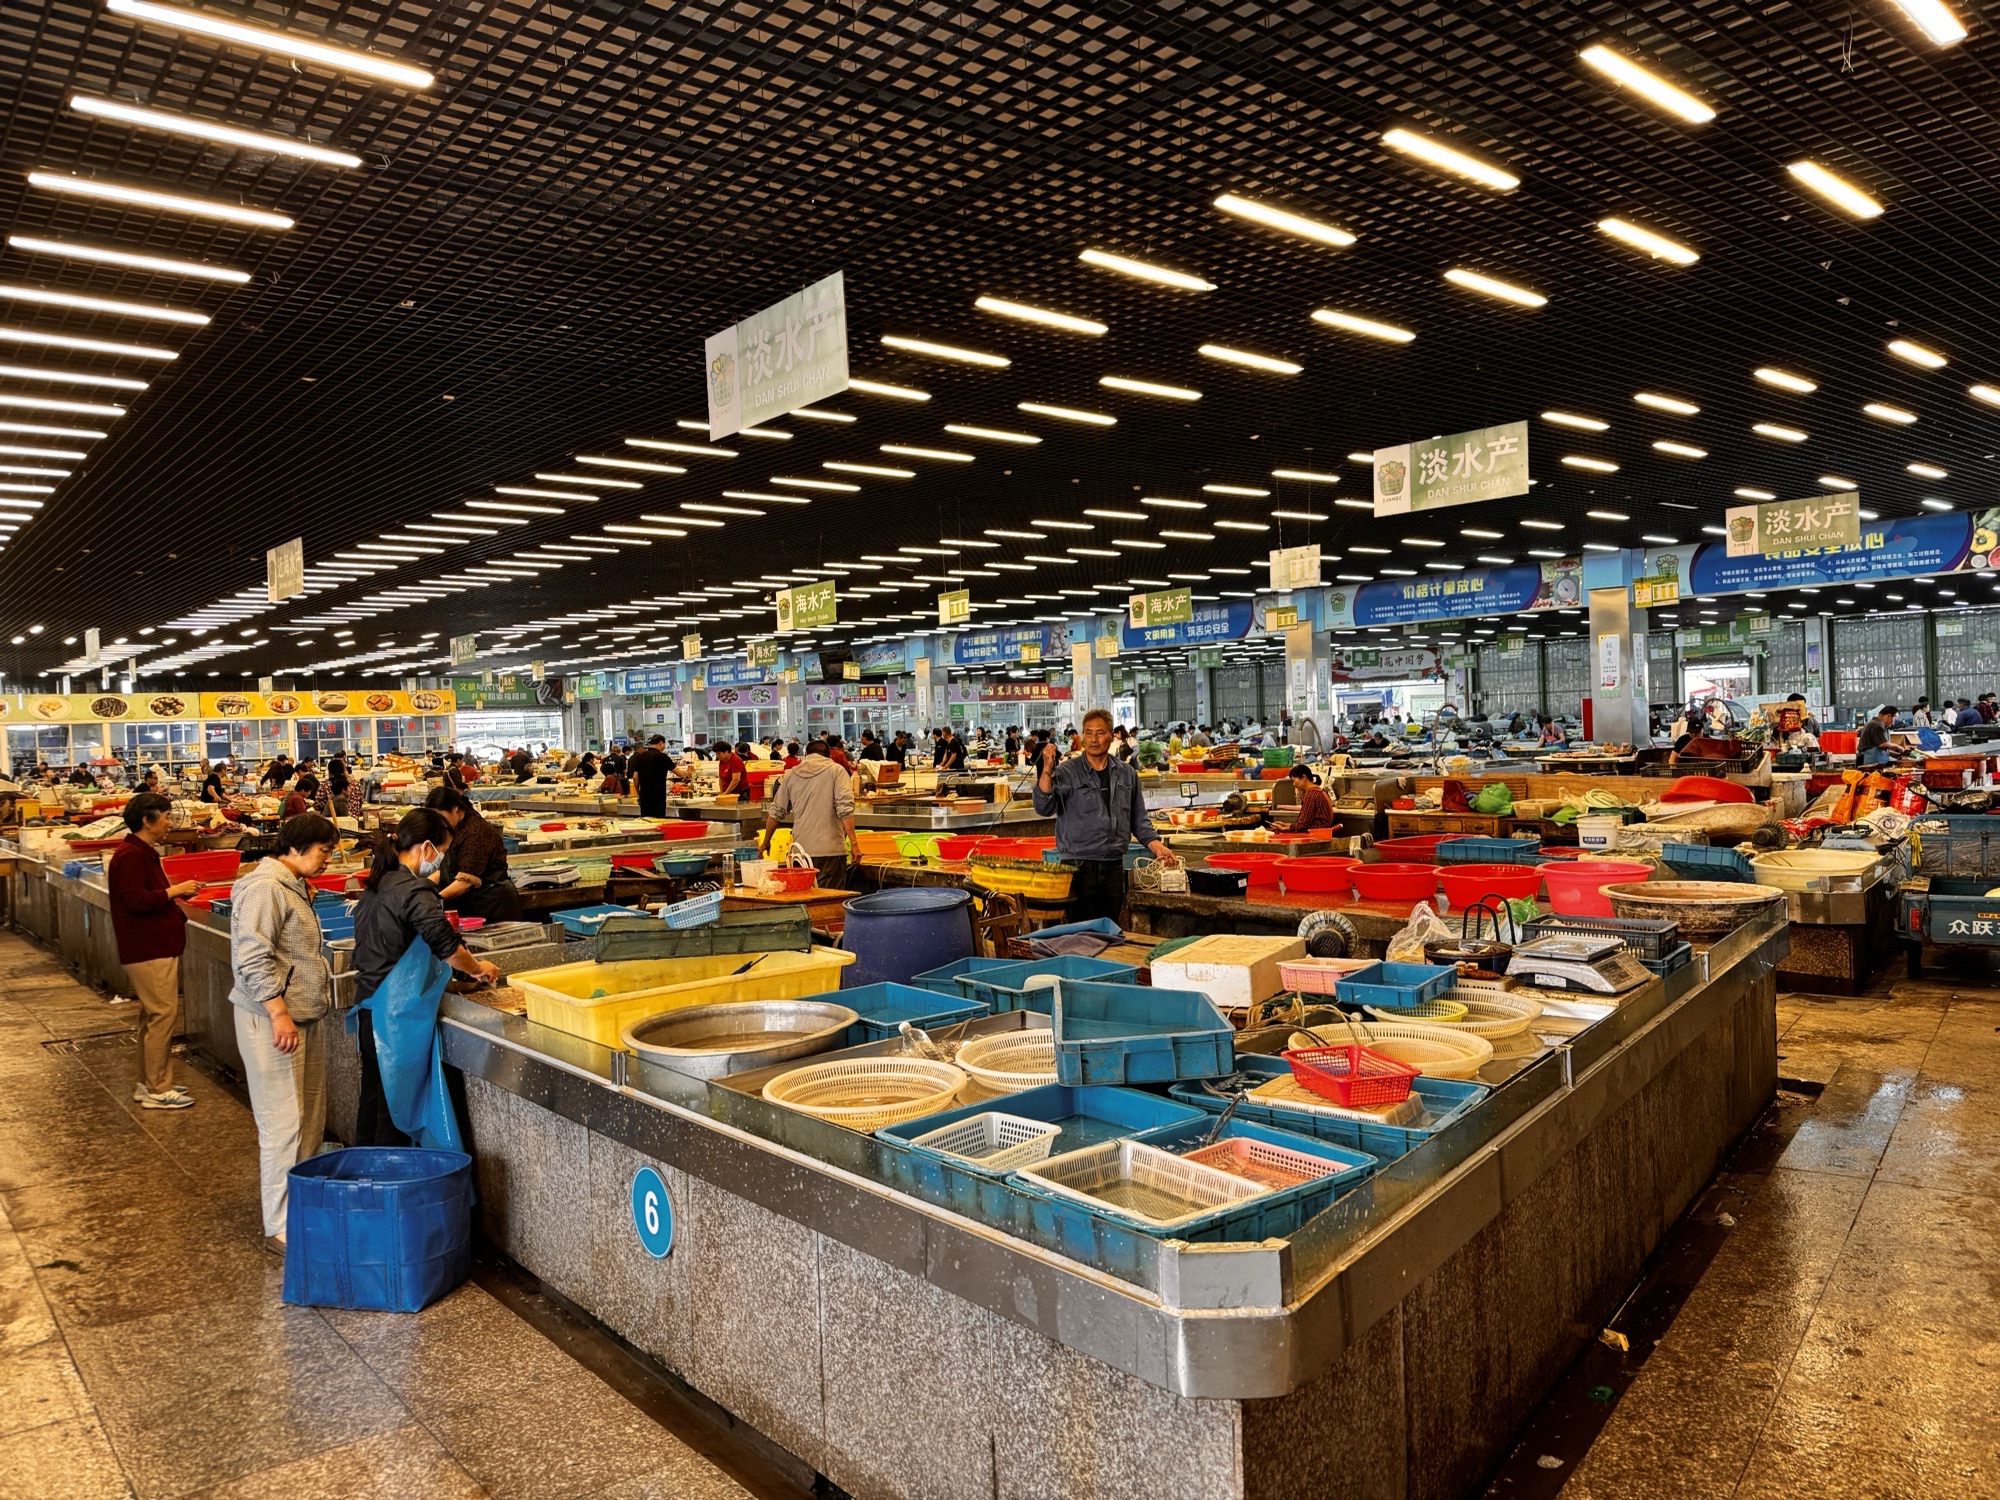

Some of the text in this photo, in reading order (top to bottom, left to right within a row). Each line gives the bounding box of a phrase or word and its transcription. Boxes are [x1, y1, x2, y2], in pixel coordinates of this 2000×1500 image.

[746, 300, 836, 386] 淡水产
[755, 365, 830, 407] DAN SHUI CHAN
[1418, 435, 1518, 486] 淡水产
[1427, 477, 1510, 499] DAN SHUI CHAN
[1765, 501, 1851, 535] 淡水产
[1773, 531, 1844, 545] DAN SHUI CHAN
[1403, 578, 1483, 599] 价格计量放心
[796, 589, 831, 613] 海水产
[1150, 594, 1187, 614] 海水产
[756, 644, 777, 659] 海水产
[645, 1190, 659, 1235] 6
